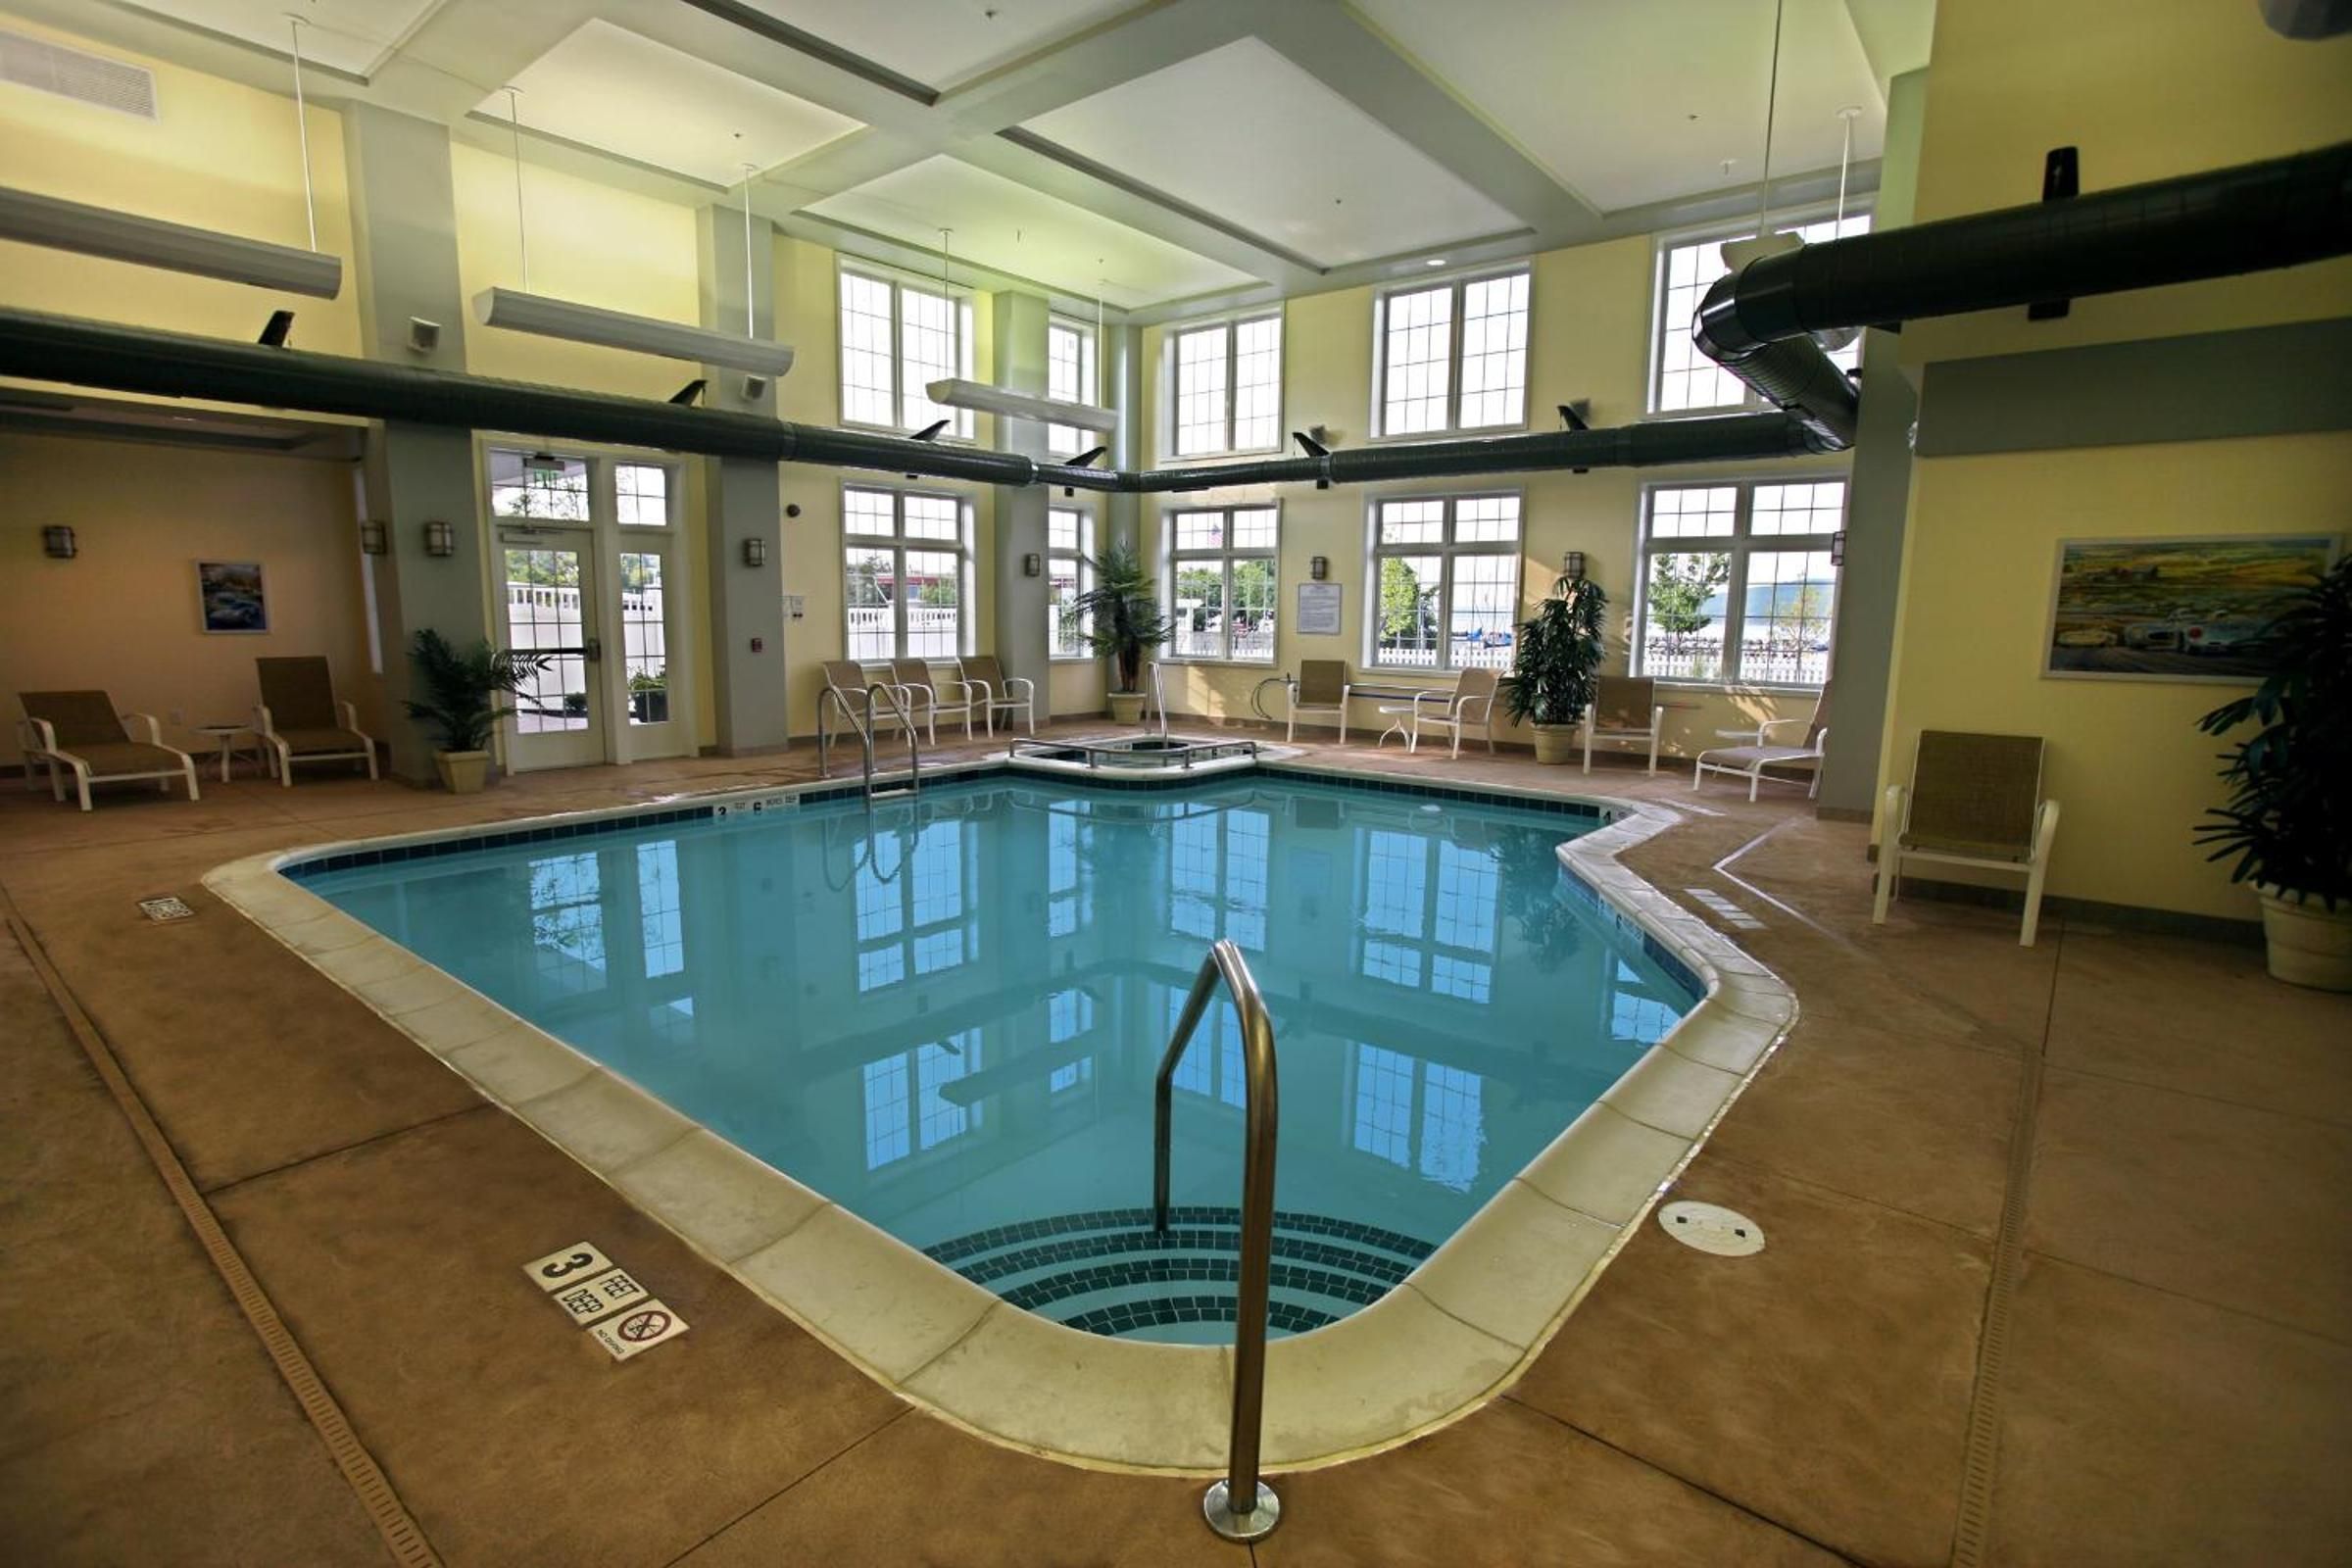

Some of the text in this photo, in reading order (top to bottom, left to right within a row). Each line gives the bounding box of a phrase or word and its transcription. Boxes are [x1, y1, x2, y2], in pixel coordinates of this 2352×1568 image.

[542, 1252, 593, 1278] 3
[599, 1274, 640, 1300] FEET
[562, 1289, 605, 1314] DEEP
